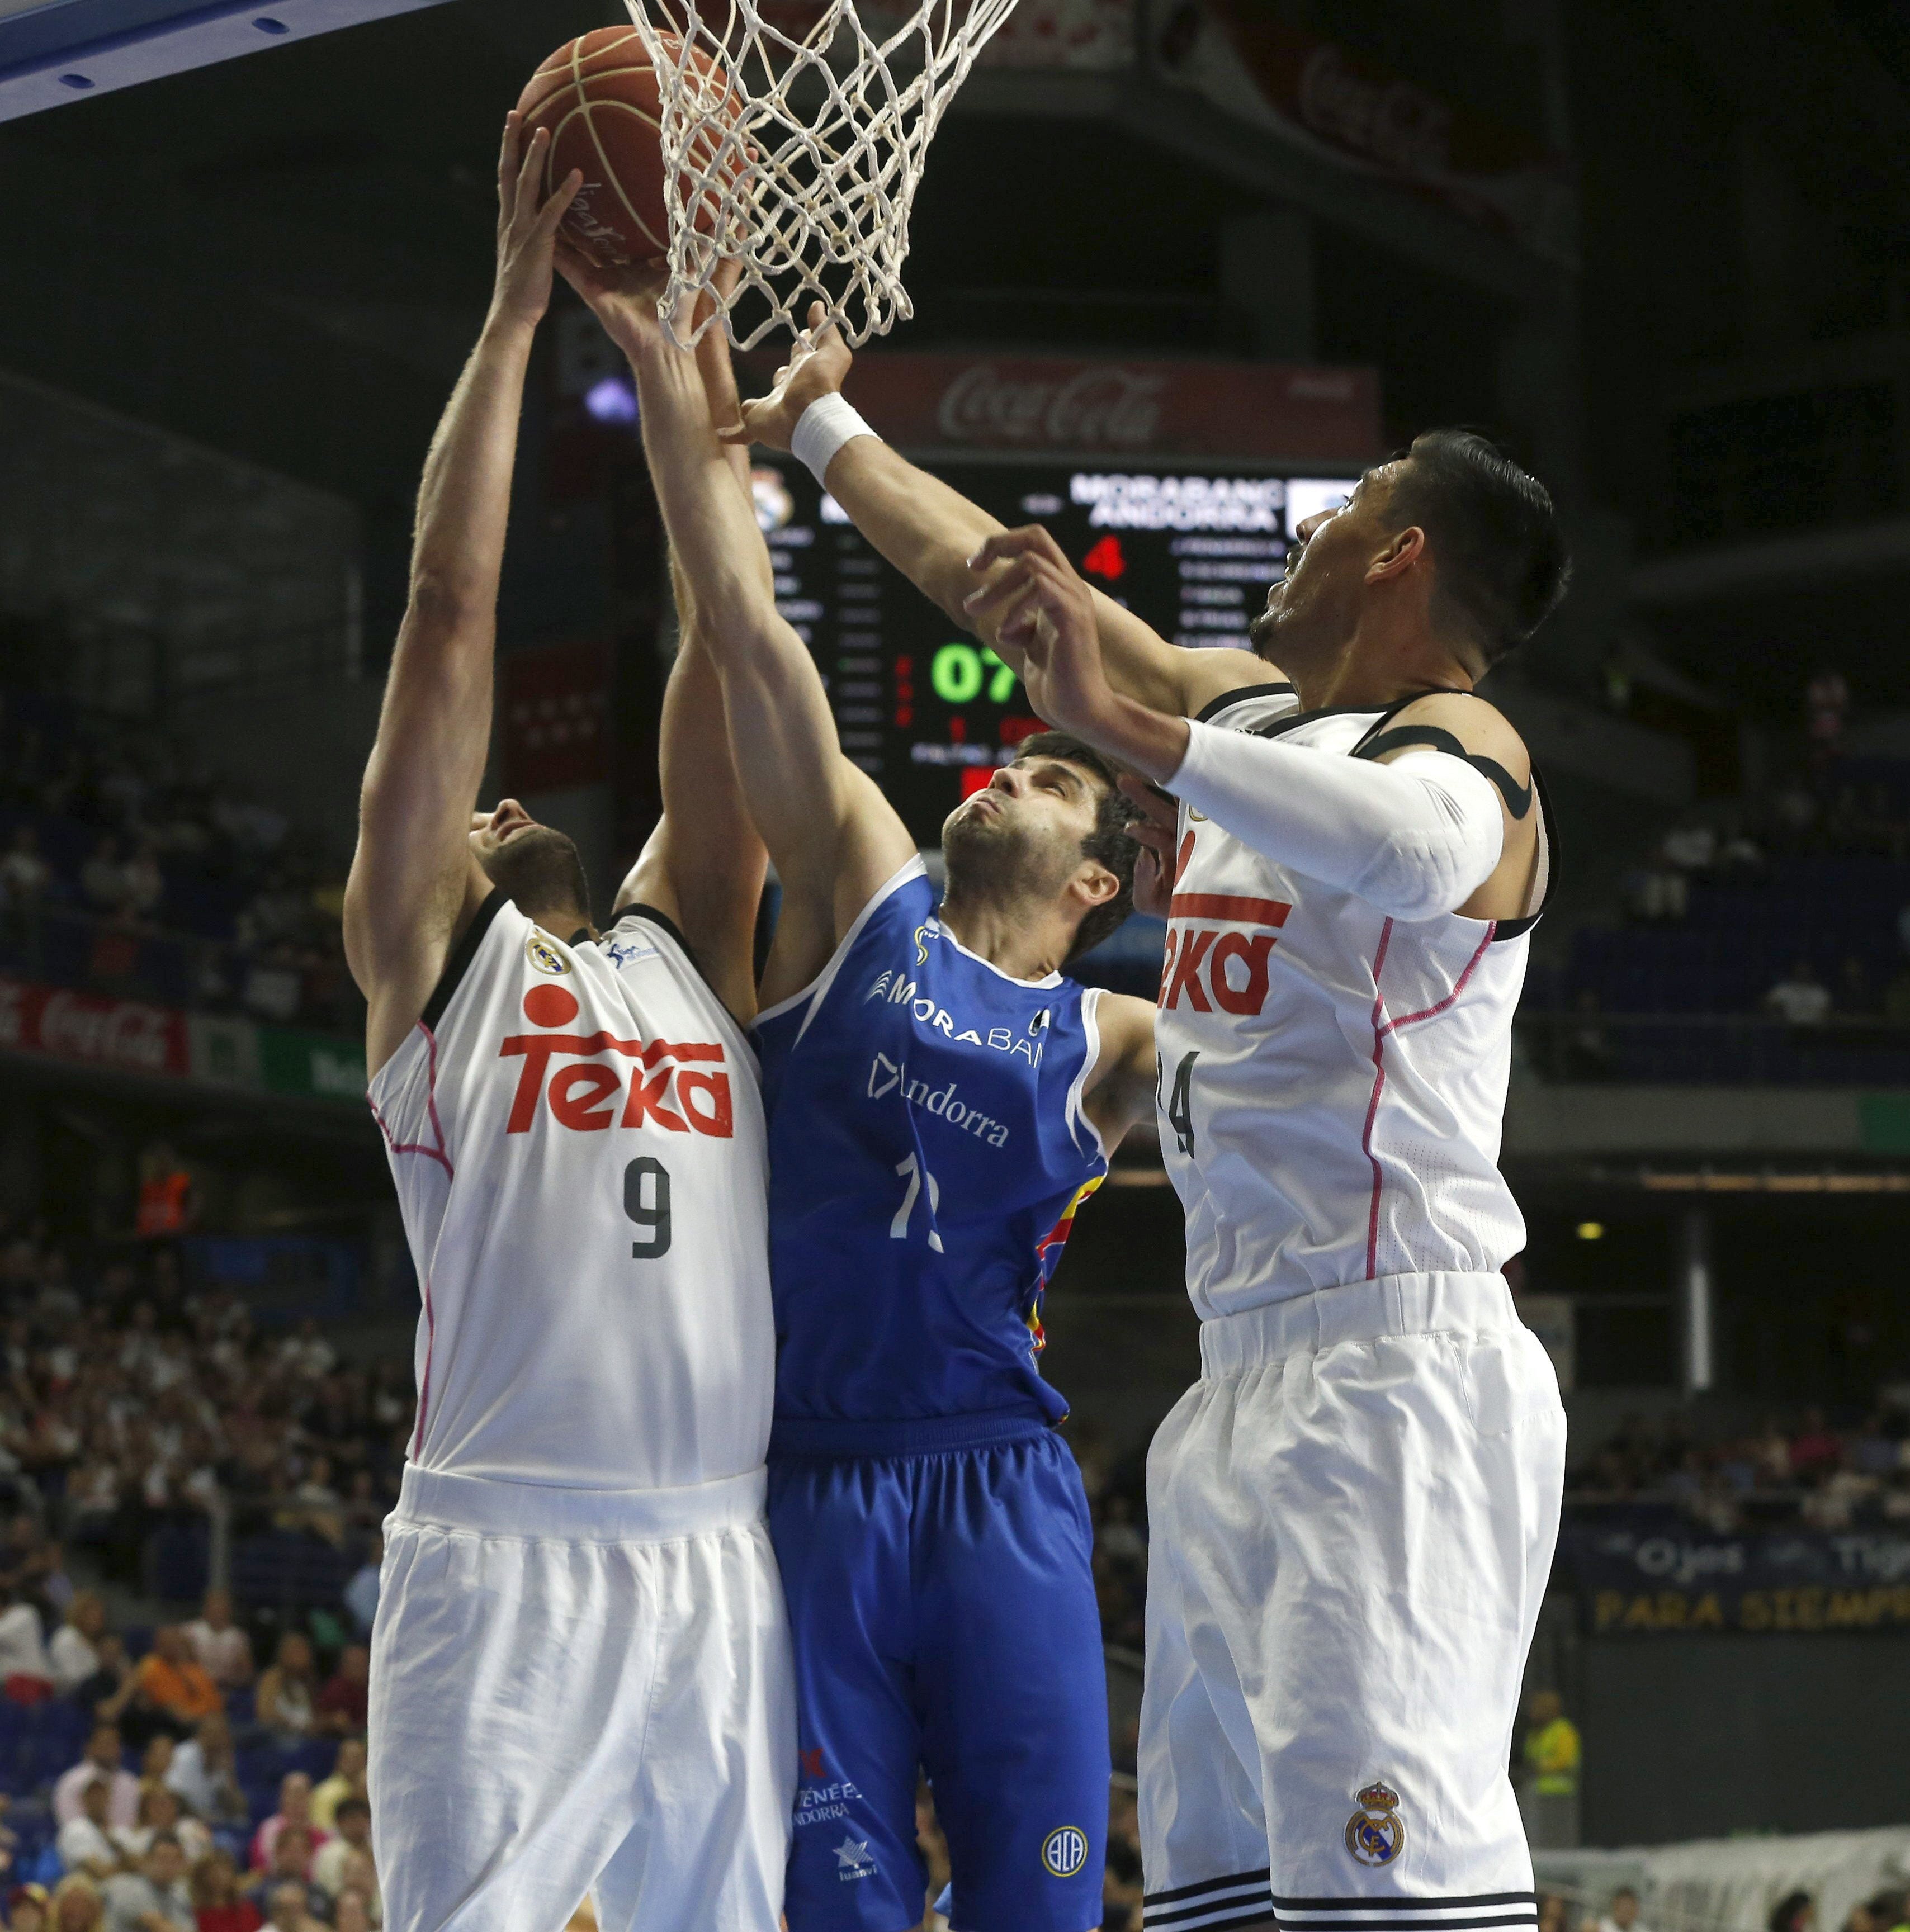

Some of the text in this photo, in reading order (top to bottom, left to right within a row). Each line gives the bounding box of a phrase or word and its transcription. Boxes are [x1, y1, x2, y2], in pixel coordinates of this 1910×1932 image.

[1084, 533, 1126, 580] 4
[1156, 893, 1293, 1016] ka
[623, 1157, 672, 1259] 9
[793, 1801, 850, 1826] NDORRA
